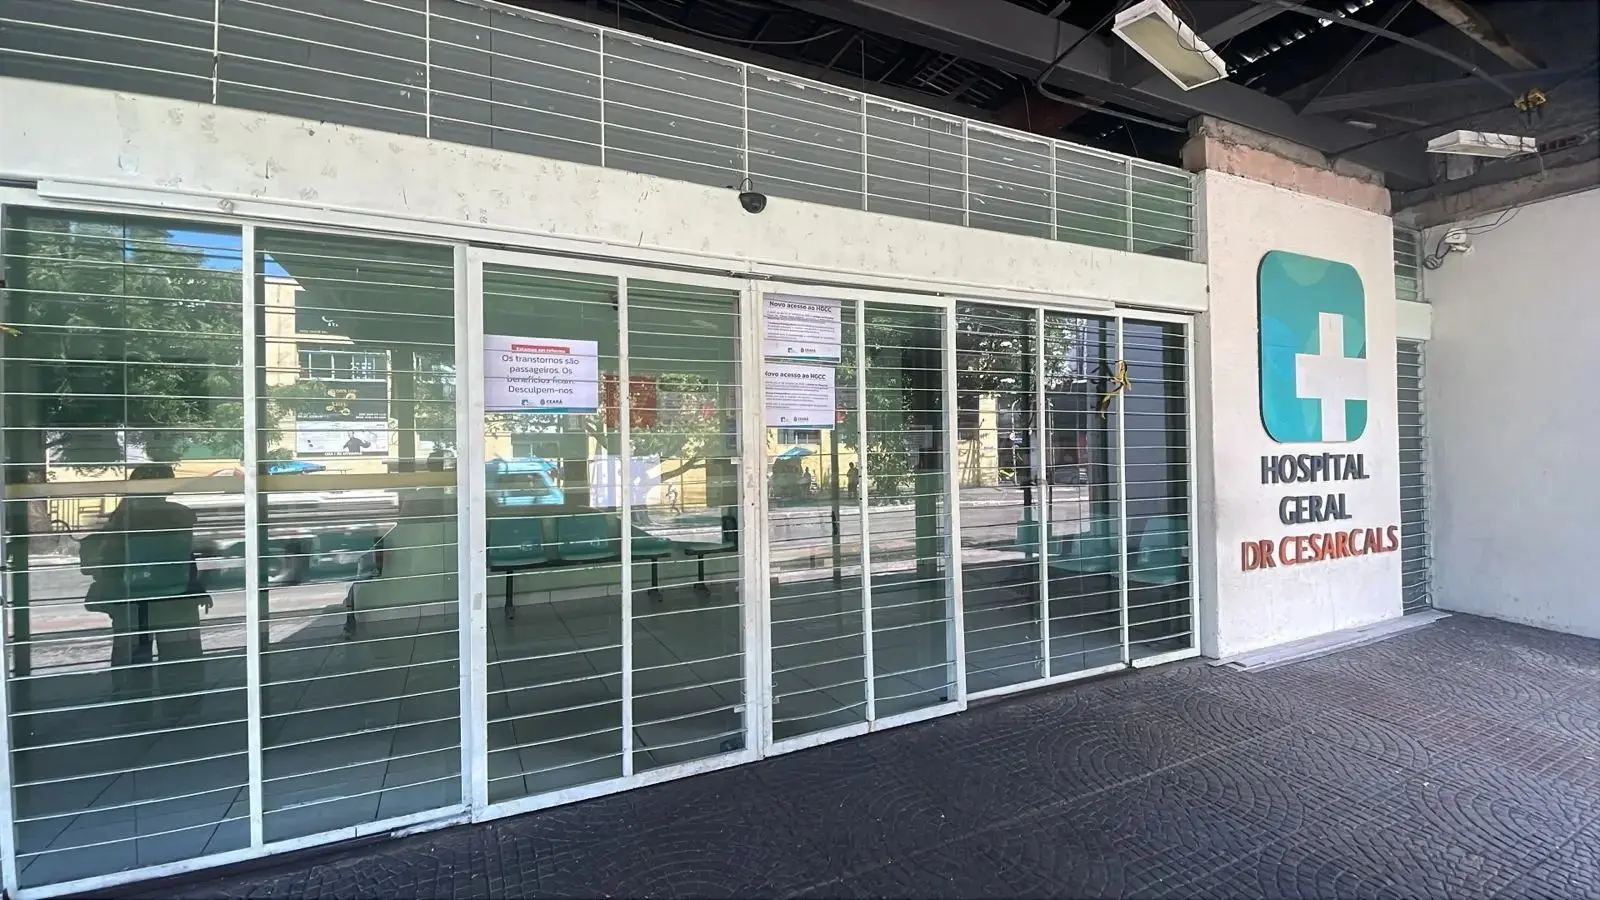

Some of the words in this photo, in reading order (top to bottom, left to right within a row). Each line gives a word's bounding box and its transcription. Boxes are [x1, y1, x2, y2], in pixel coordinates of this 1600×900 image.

[501, 354, 513, 362] Os
[515, 355, 563, 364] transtornos
[509, 366, 560, 374] passageiros.
[1261, 453, 1370, 484] HOSPITAL
[1279, 493, 1352, 525] GERAL
[1241, 540, 1276, 572] DR
